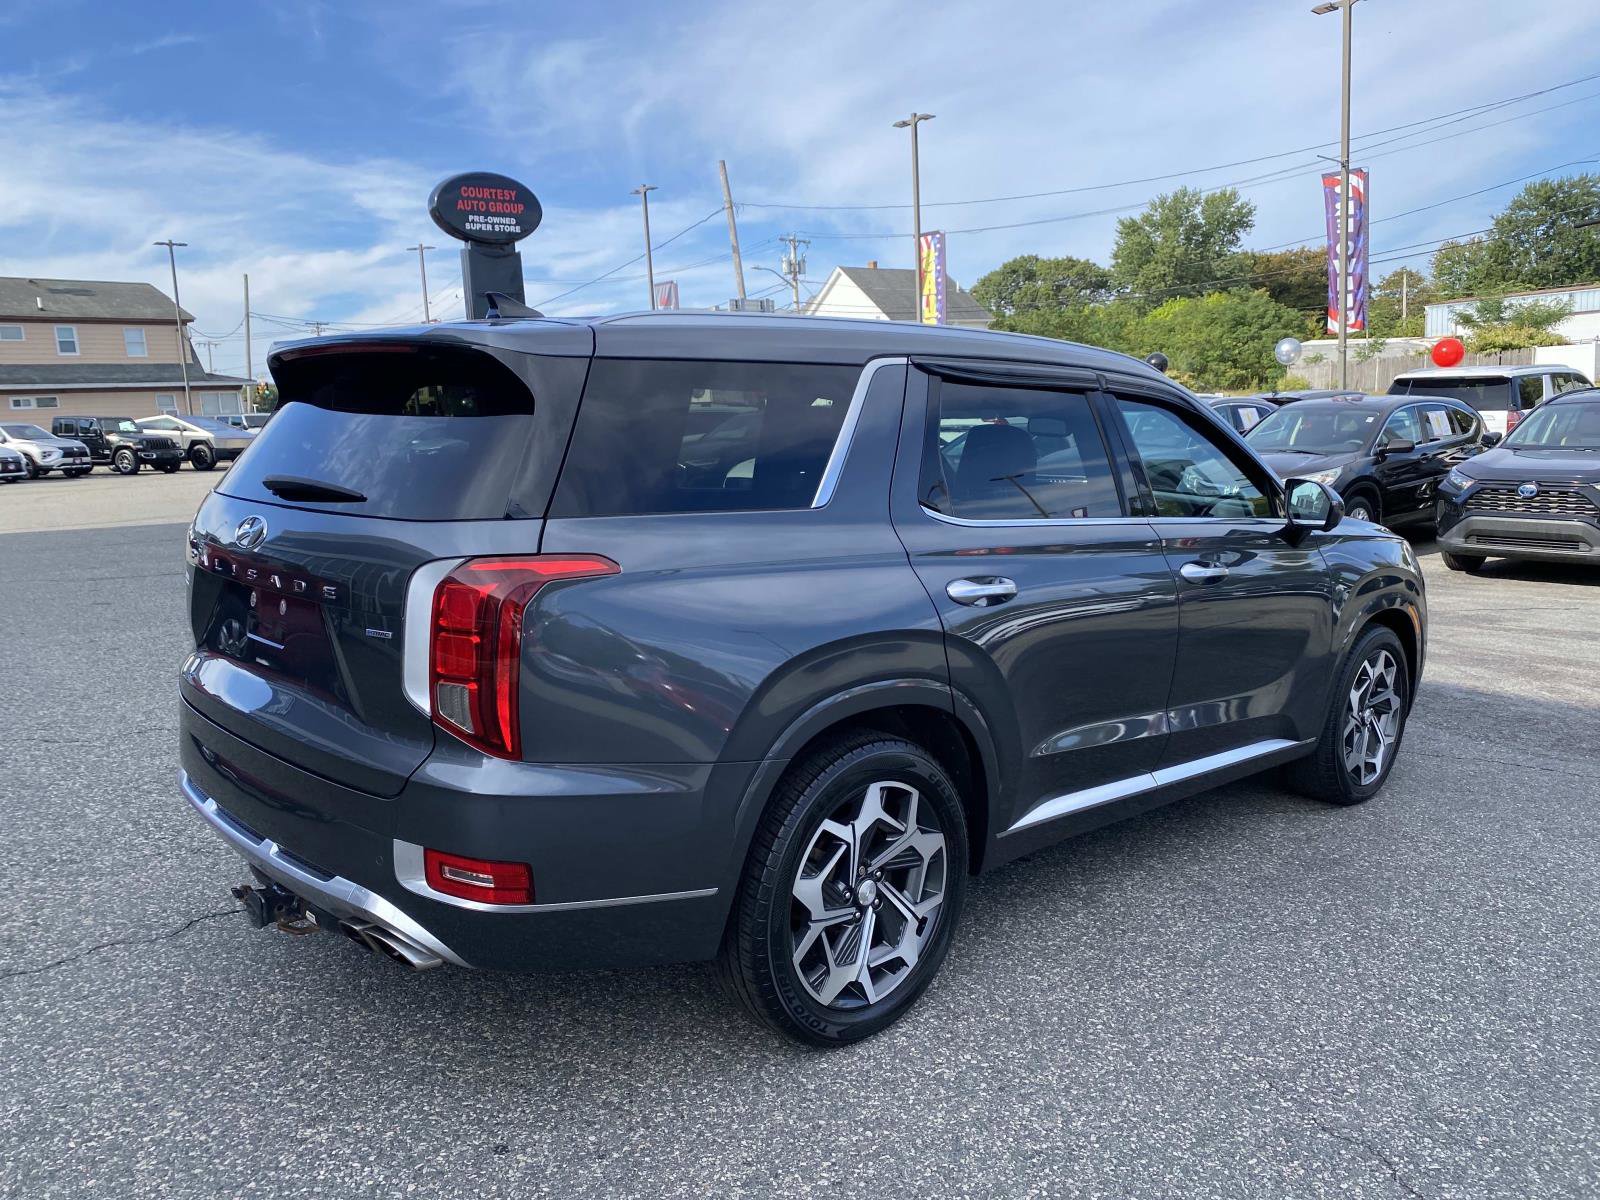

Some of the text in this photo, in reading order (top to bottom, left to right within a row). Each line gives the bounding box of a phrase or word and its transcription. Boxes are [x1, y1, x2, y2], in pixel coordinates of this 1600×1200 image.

[461, 187, 516, 200] COURTESY
[457, 200, 524, 214] AUTO GROUP
[469, 215, 516, 224] PRE-OWNED
[465, 223, 492, 231] SUPER
